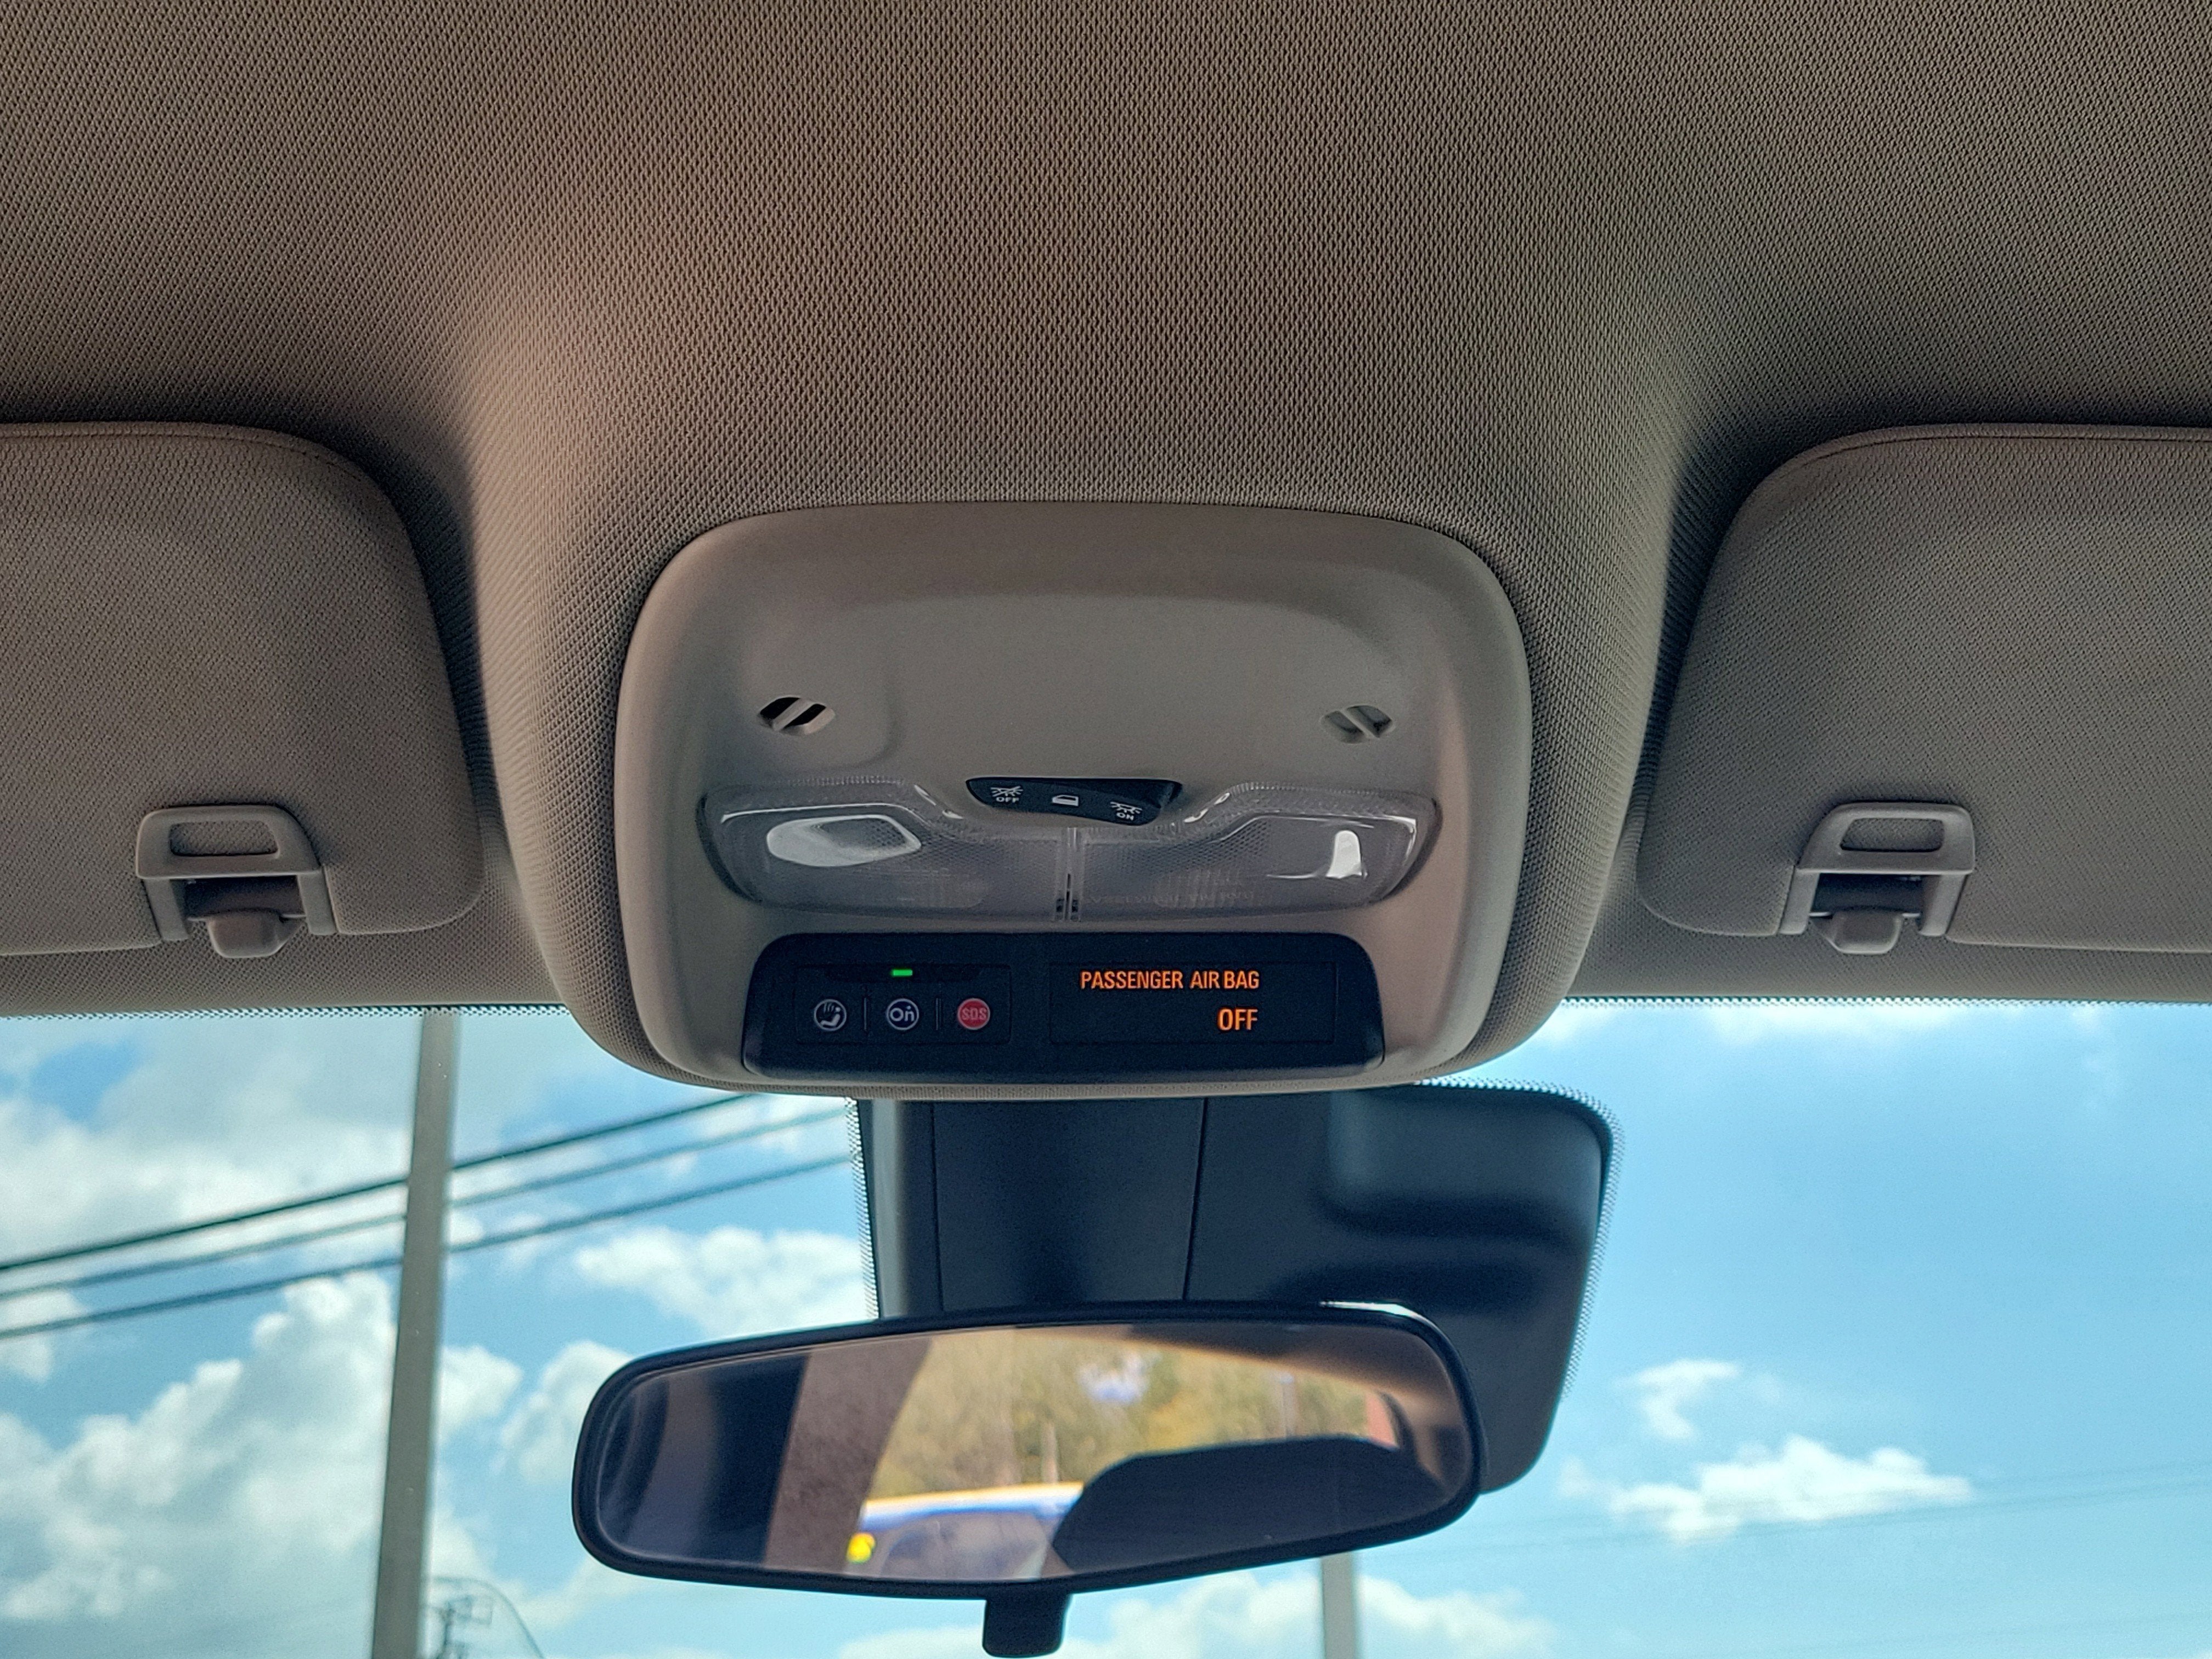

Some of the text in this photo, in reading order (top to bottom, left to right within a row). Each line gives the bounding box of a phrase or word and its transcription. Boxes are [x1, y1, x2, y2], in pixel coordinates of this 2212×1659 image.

[1116, 812, 1134, 821] ON
[1080, 970, 1260, 989] PASSENGER AIR BAG
[961, 1007, 988, 1022] SOS
[1217, 1008, 1259, 1030] OFF
